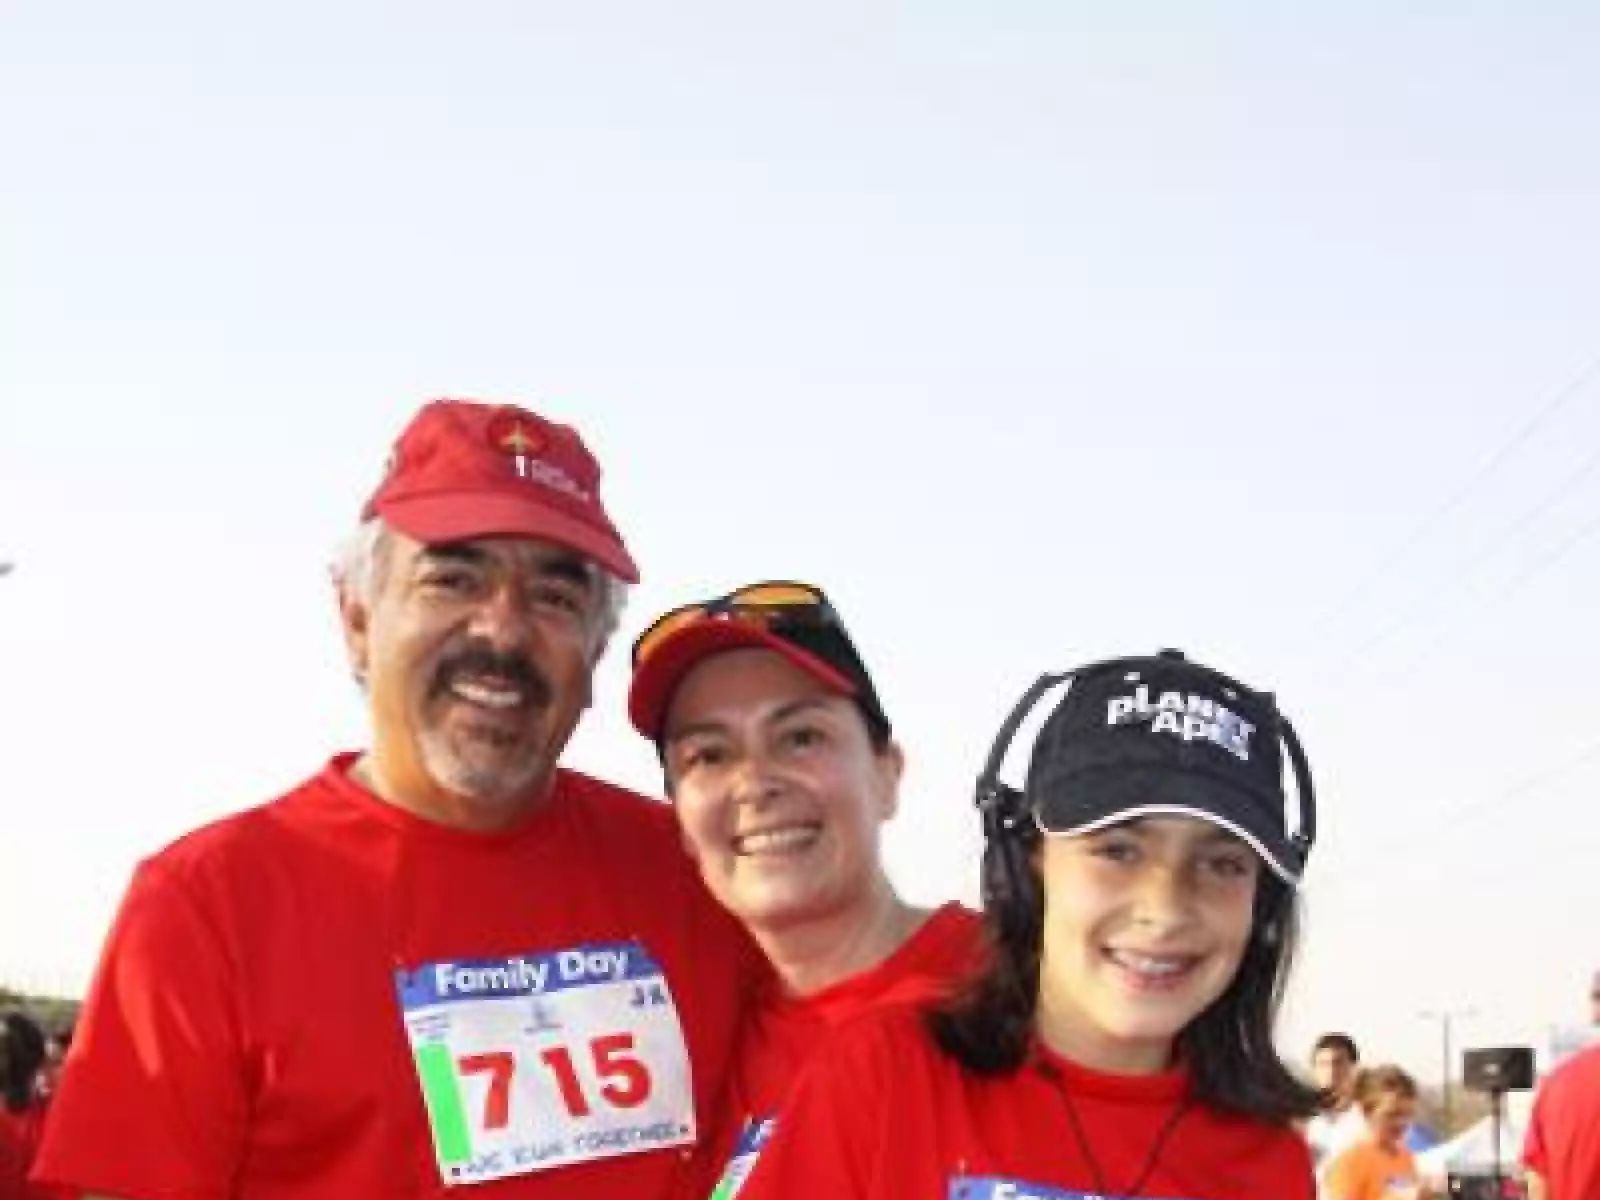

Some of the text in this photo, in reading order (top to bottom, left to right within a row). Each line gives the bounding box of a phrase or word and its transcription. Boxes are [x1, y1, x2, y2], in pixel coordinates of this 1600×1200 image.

[434, 950, 629, 996] Family Day
[457, 1032, 653, 1131] 715
